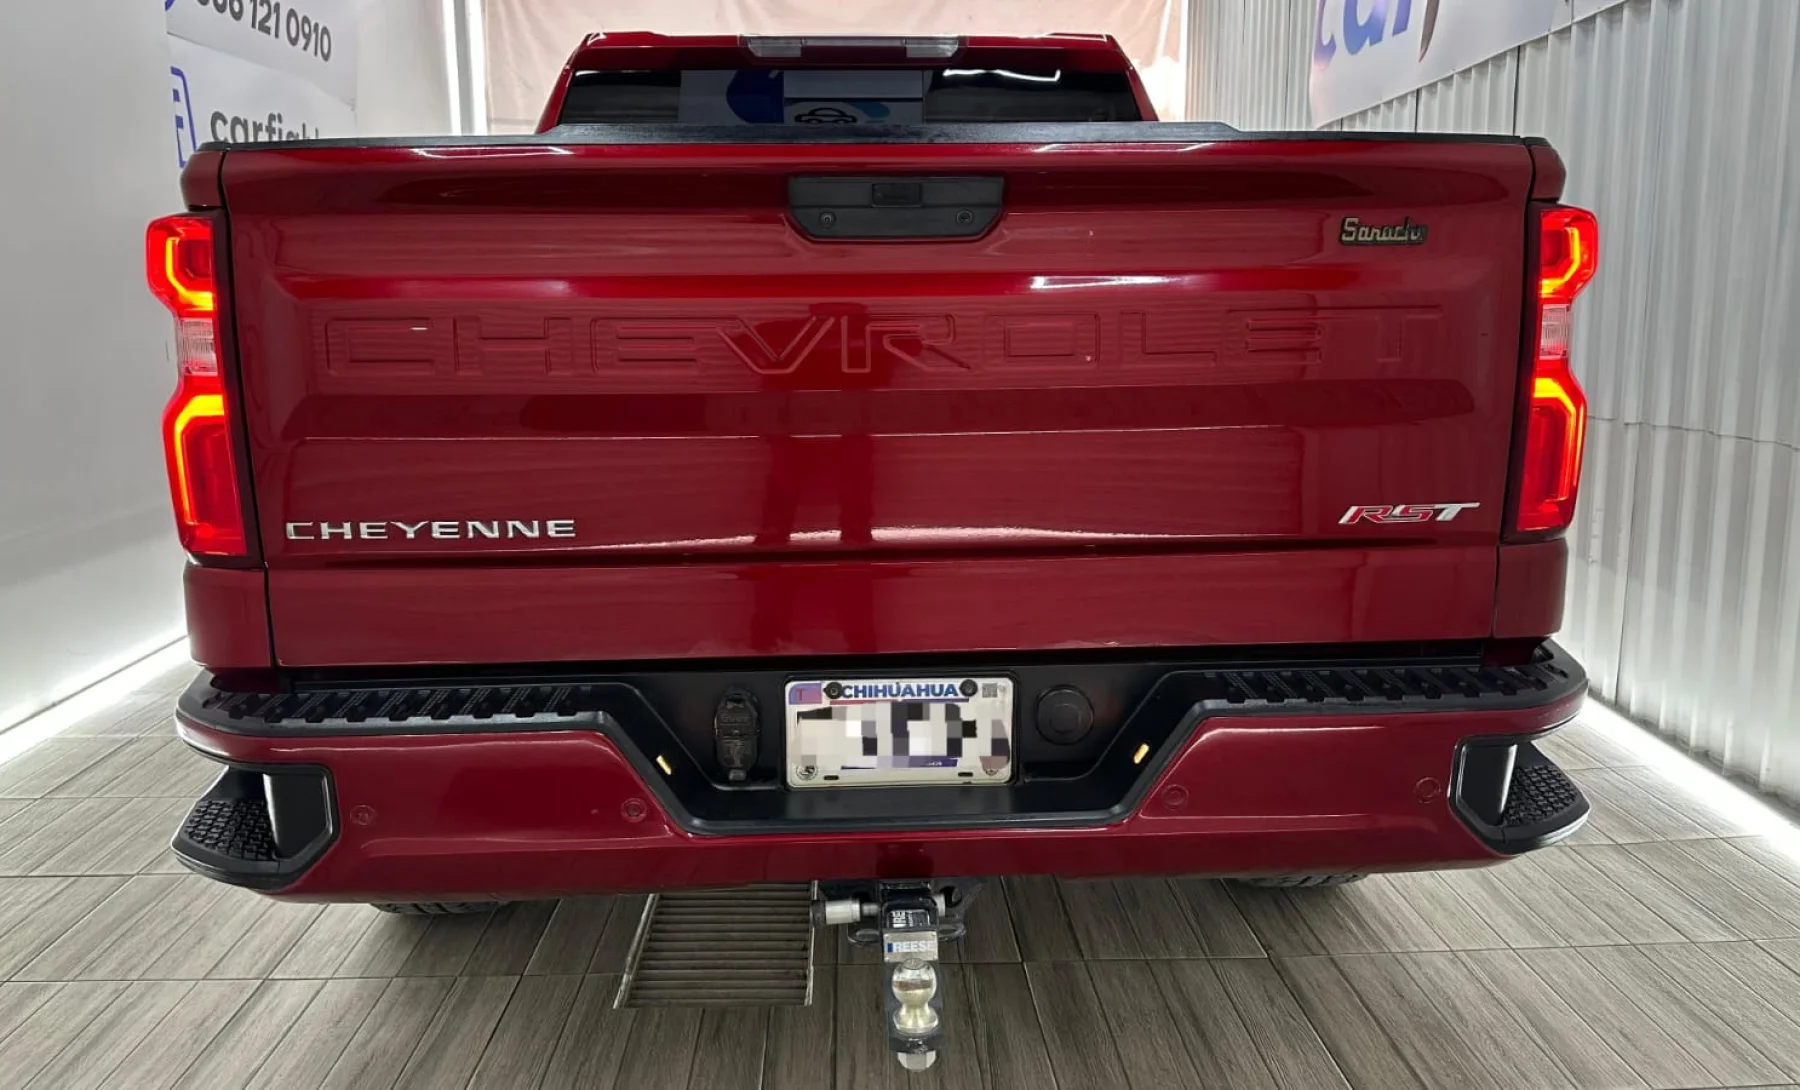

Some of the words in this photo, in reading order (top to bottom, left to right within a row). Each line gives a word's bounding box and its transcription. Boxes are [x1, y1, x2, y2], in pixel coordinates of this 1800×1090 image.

[250, 0, 281, 39] 121
[286, 8, 332, 62] 0910
[325, 304, 1444, 376] CHEVROLET
[1338, 502, 1481, 525] RST
[285, 519, 577, 540] CHEYENNE
[840, 683, 959, 699] CHIHUAHUA
[893, 940, 936, 952] REESE
